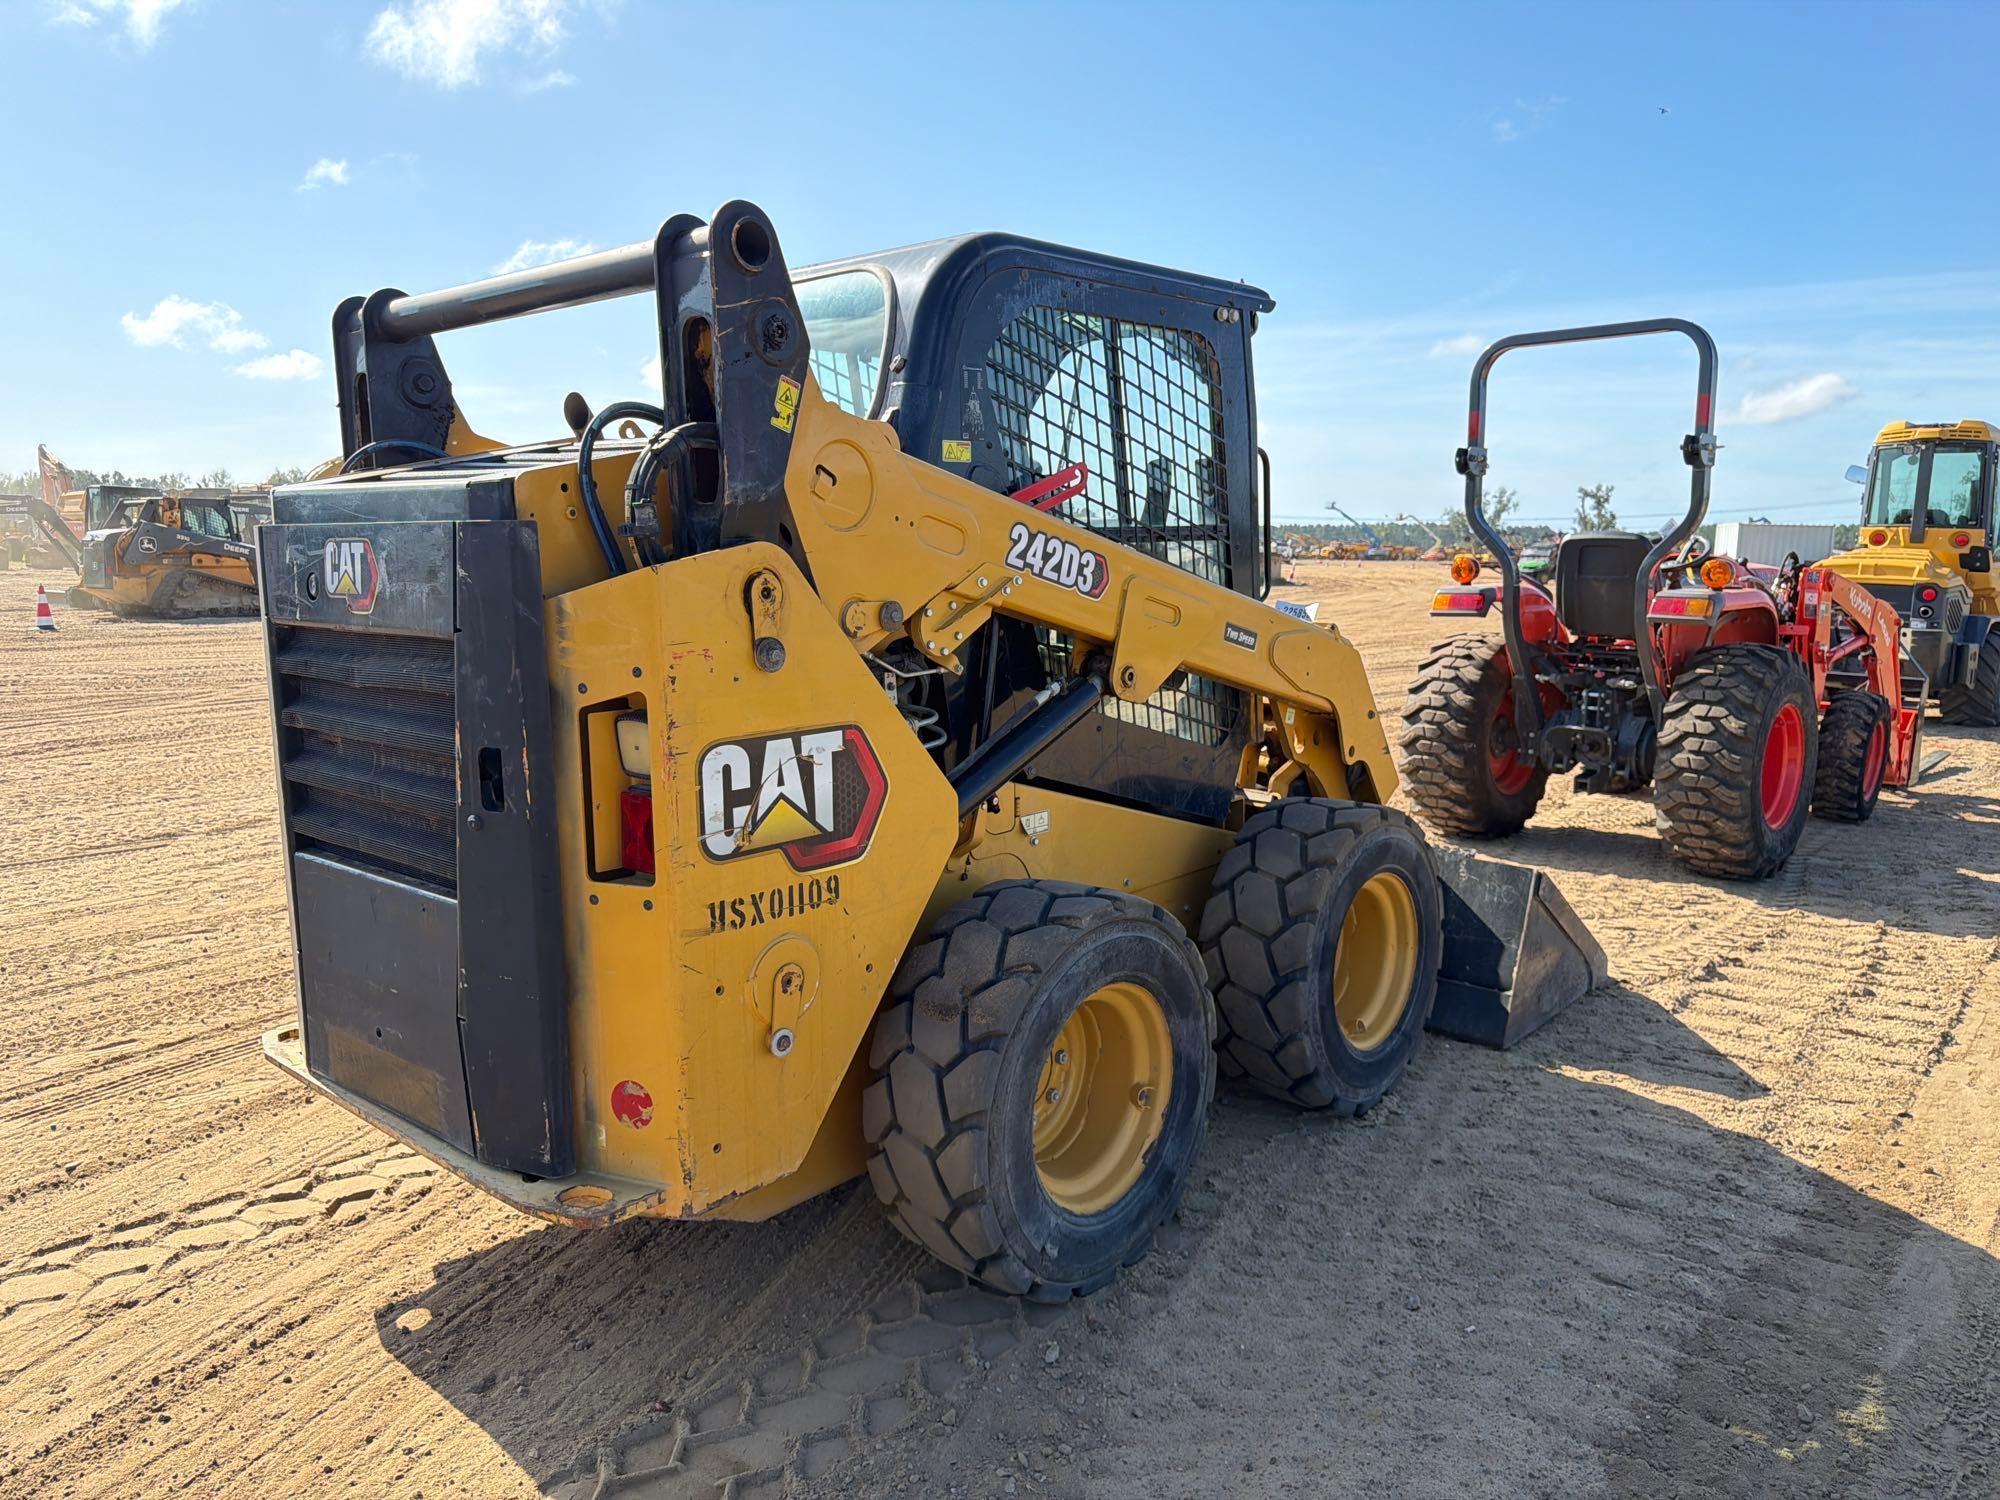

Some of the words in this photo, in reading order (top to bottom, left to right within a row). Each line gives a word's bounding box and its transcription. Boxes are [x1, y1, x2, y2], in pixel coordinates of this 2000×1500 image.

[223, 542, 250, 555] DEERE
[325, 541, 364, 594] CAT
[1006, 523, 1096, 593] 242D3
[702, 730, 843, 855] CAT
